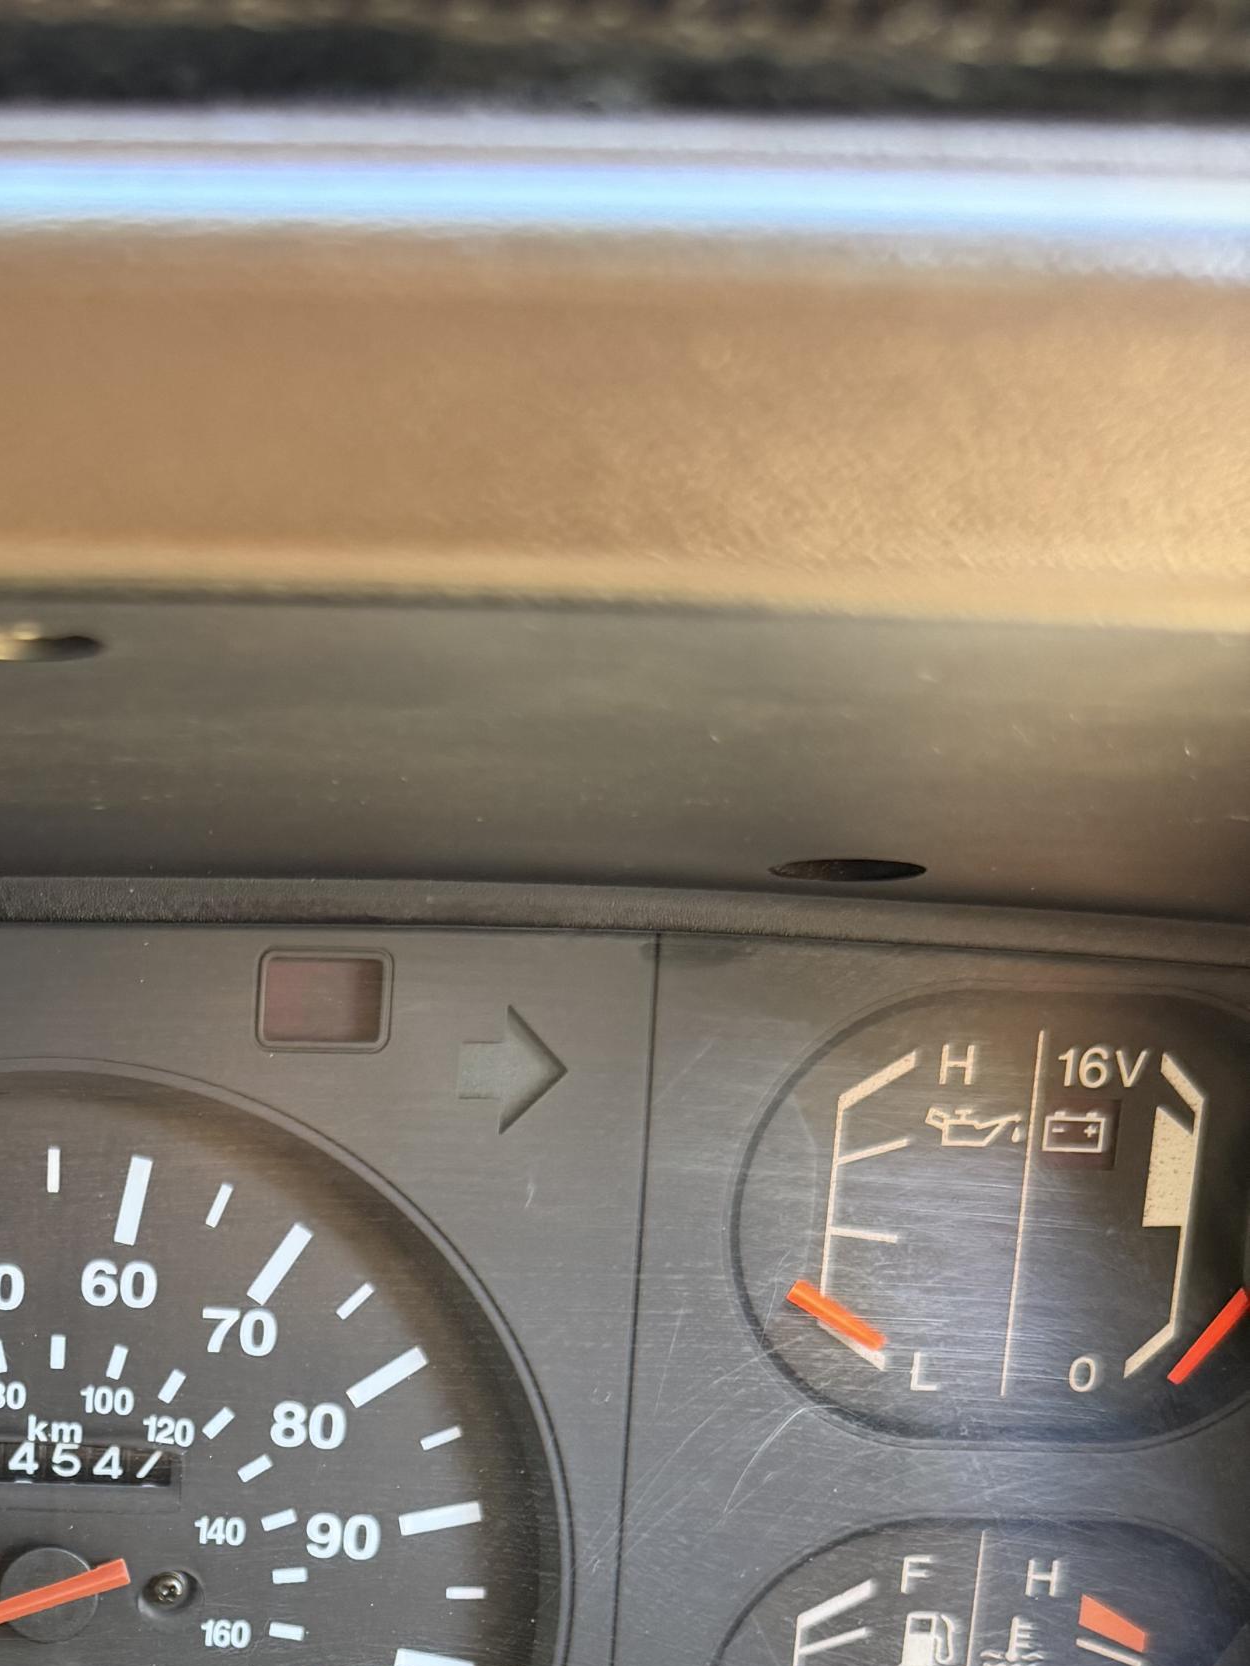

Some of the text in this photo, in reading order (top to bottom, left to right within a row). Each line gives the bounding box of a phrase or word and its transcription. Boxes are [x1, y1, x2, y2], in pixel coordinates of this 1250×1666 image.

[938, 1043, 976, 1086] H
[1057, 1046, 1149, 1088] 16V
[81, 1259, 158, 1309] 60
[202, 1305, 279, 1357] 70
[910, 1351, 939, 1392] L
[1068, 1356, 1099, 1393] 0
[80, 1386, 135, 1417] 100
[27, 1414, 83, 1444] km
[142, 1414, 195, 1448] 120
[269, 1400, 347, 1450] 80
[194, 1516, 246, 1547] 140
[305, 1512, 381, 1561] 90
[901, 1555, 934, 1594] F
[1025, 1559, 1060, 1597] H
[201, 1619, 251, 1649] 160
